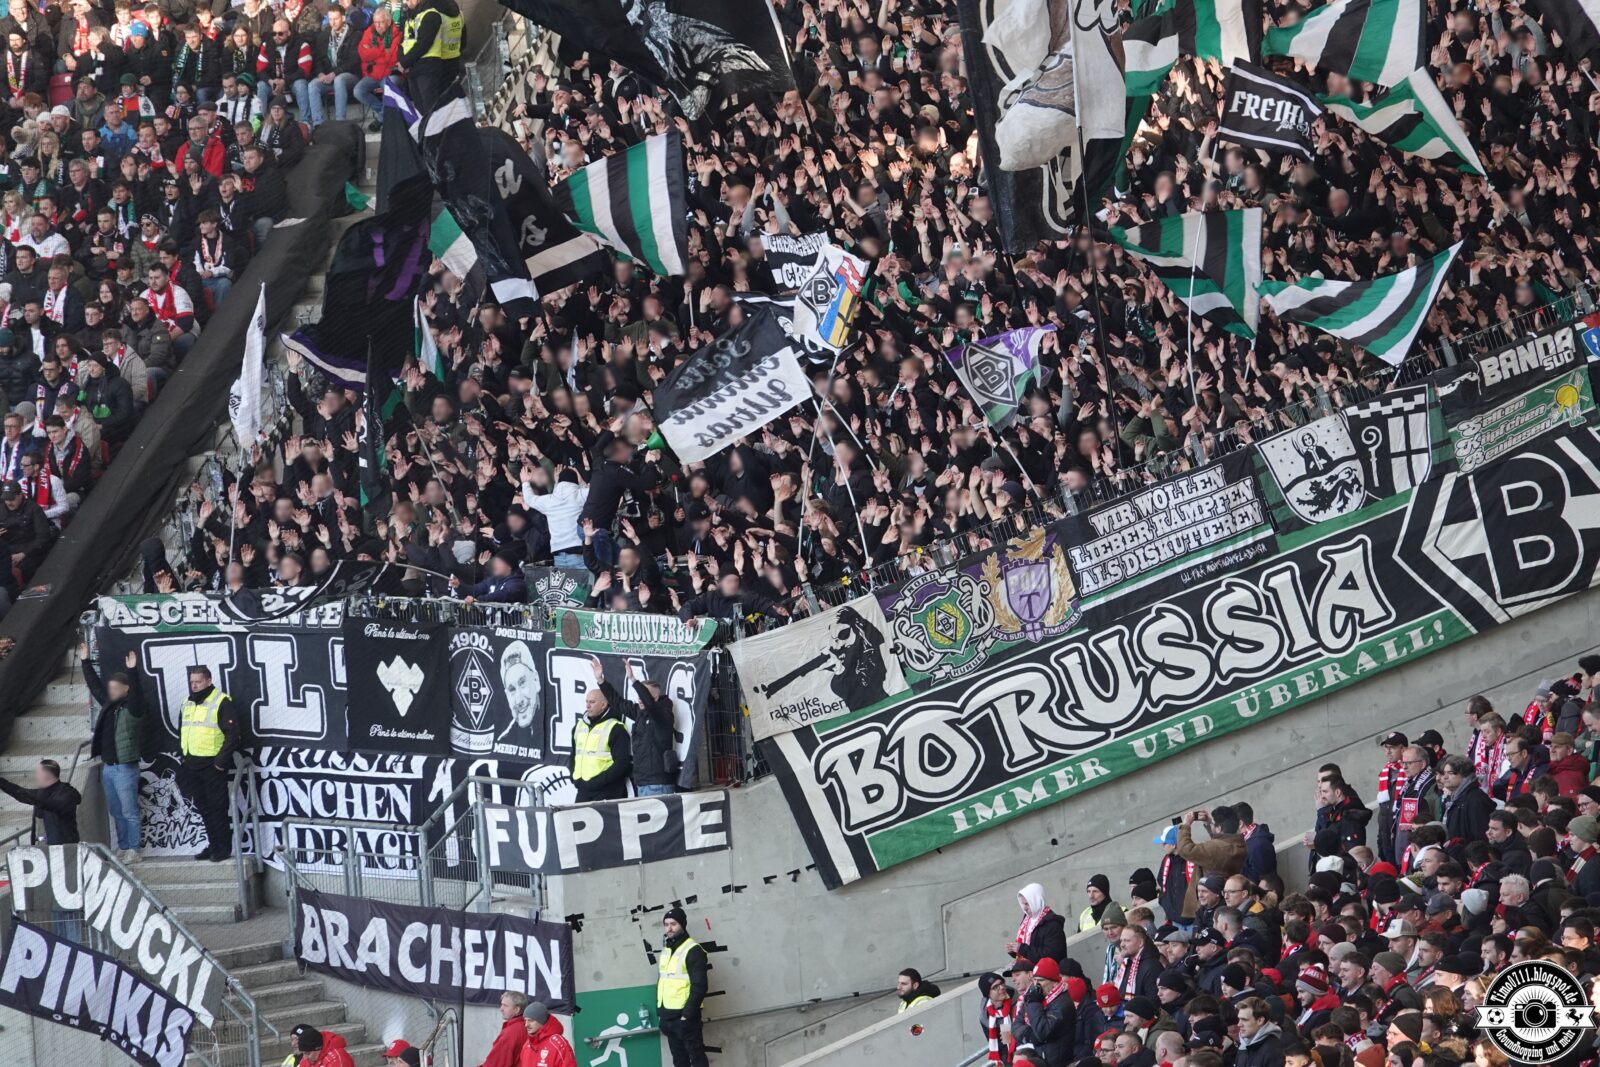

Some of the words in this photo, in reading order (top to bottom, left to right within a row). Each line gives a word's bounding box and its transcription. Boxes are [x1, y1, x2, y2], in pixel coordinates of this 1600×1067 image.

[1480, 327, 1576, 386] BANDA
[1543, 351, 1574, 372] SUD
[1089, 502, 1137, 536] WIR
[1132, 464, 1225, 516] WOLLEN
[1068, 520, 1154, 571] LIEBER
[1080, 556, 1123, 596] ALS
[1122, 500, 1263, 577] DISKUTIEREN
[907, 573, 937, 593] NORD
[452, 632, 488, 650] 1900
[593, 613, 706, 644] STADIONVERBOT
[769, 695, 821, 721] rabauke
[799, 698, 849, 722] bleiben
[816, 535, 1398, 834] BORUSSIA
[951, 758, 1113, 833] IMMER
[1133, 714, 1216, 759] UND
[1230, 620, 1450, 717] ÜBERALL!
[485, 789, 728, 870] FUPPE
[301, 903, 562, 999] BRACHELEN
[0, 923, 193, 1067] PINKIS
[52, 1012, 80, 1027] ON
[98, 1026, 138, 1057] TOUR
